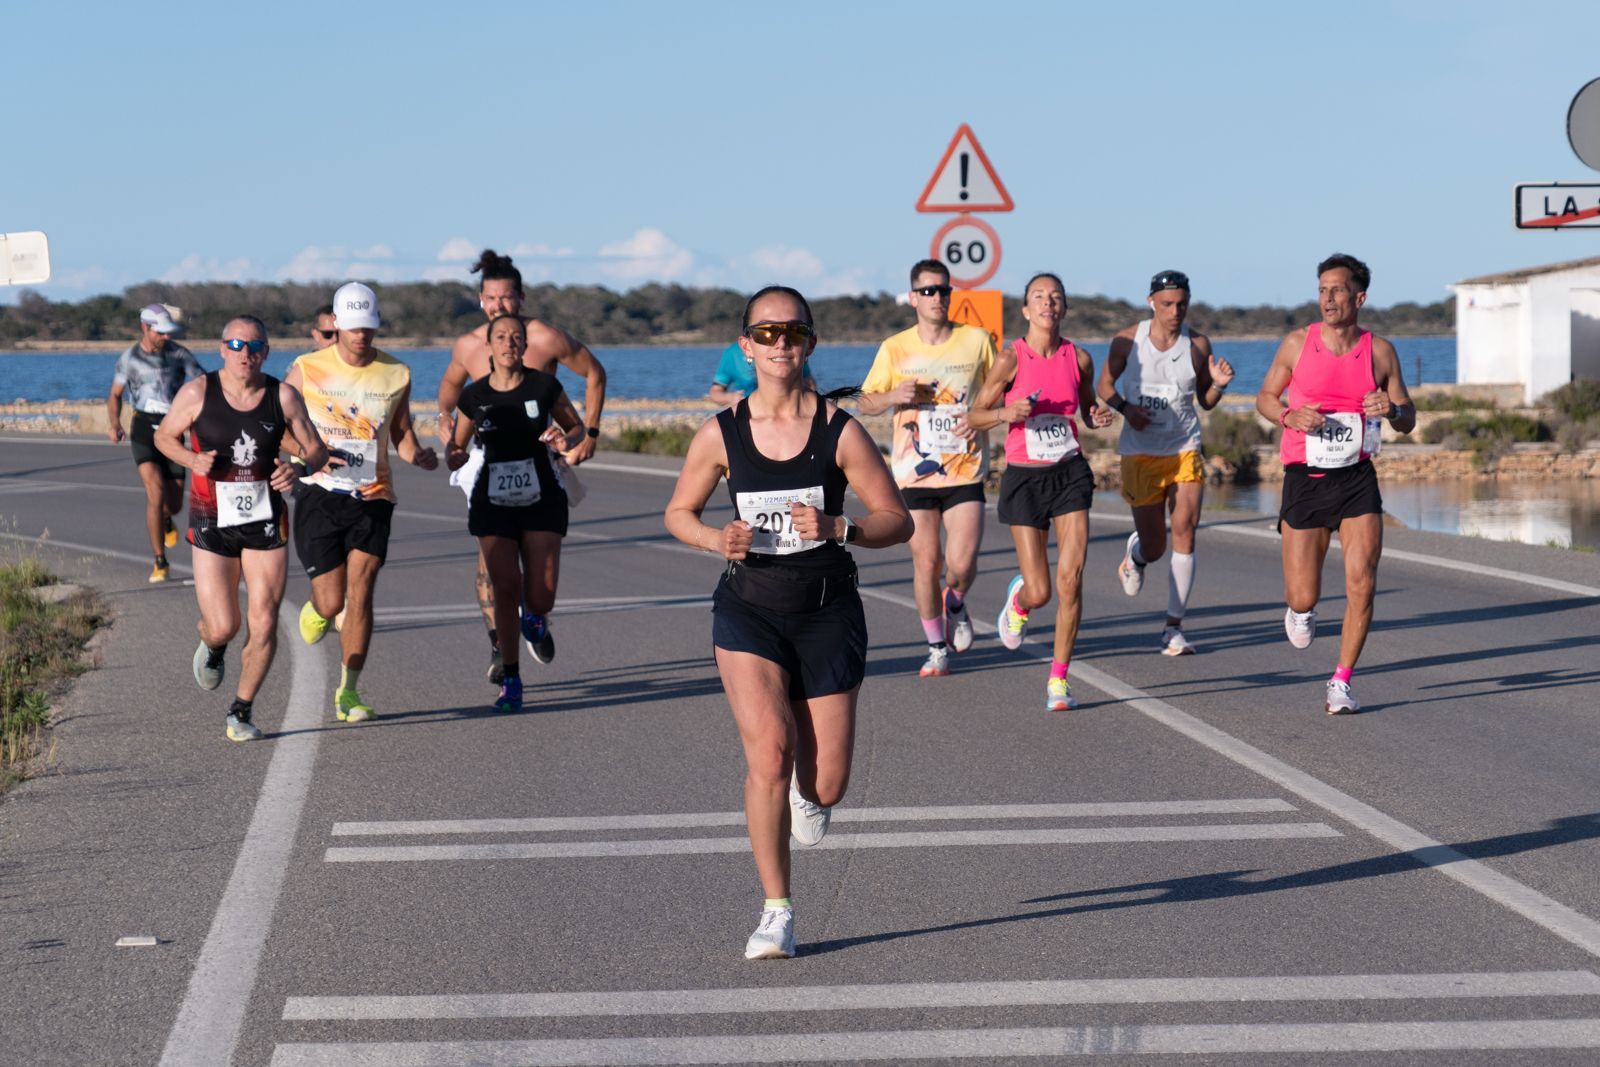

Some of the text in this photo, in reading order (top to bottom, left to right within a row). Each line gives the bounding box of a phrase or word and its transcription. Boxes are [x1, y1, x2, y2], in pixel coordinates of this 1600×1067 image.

[1544, 195, 1580, 217] LA
[946, 240, 986, 265] 60
[1137, 396, 1169, 410] 1360
[1035, 422, 1067, 441] 1160
[1317, 426, 1353, 443] 1162
[347, 453, 364, 467] 09
[497, 472, 532, 490] 2702
[235, 495, 253, 511] 28
